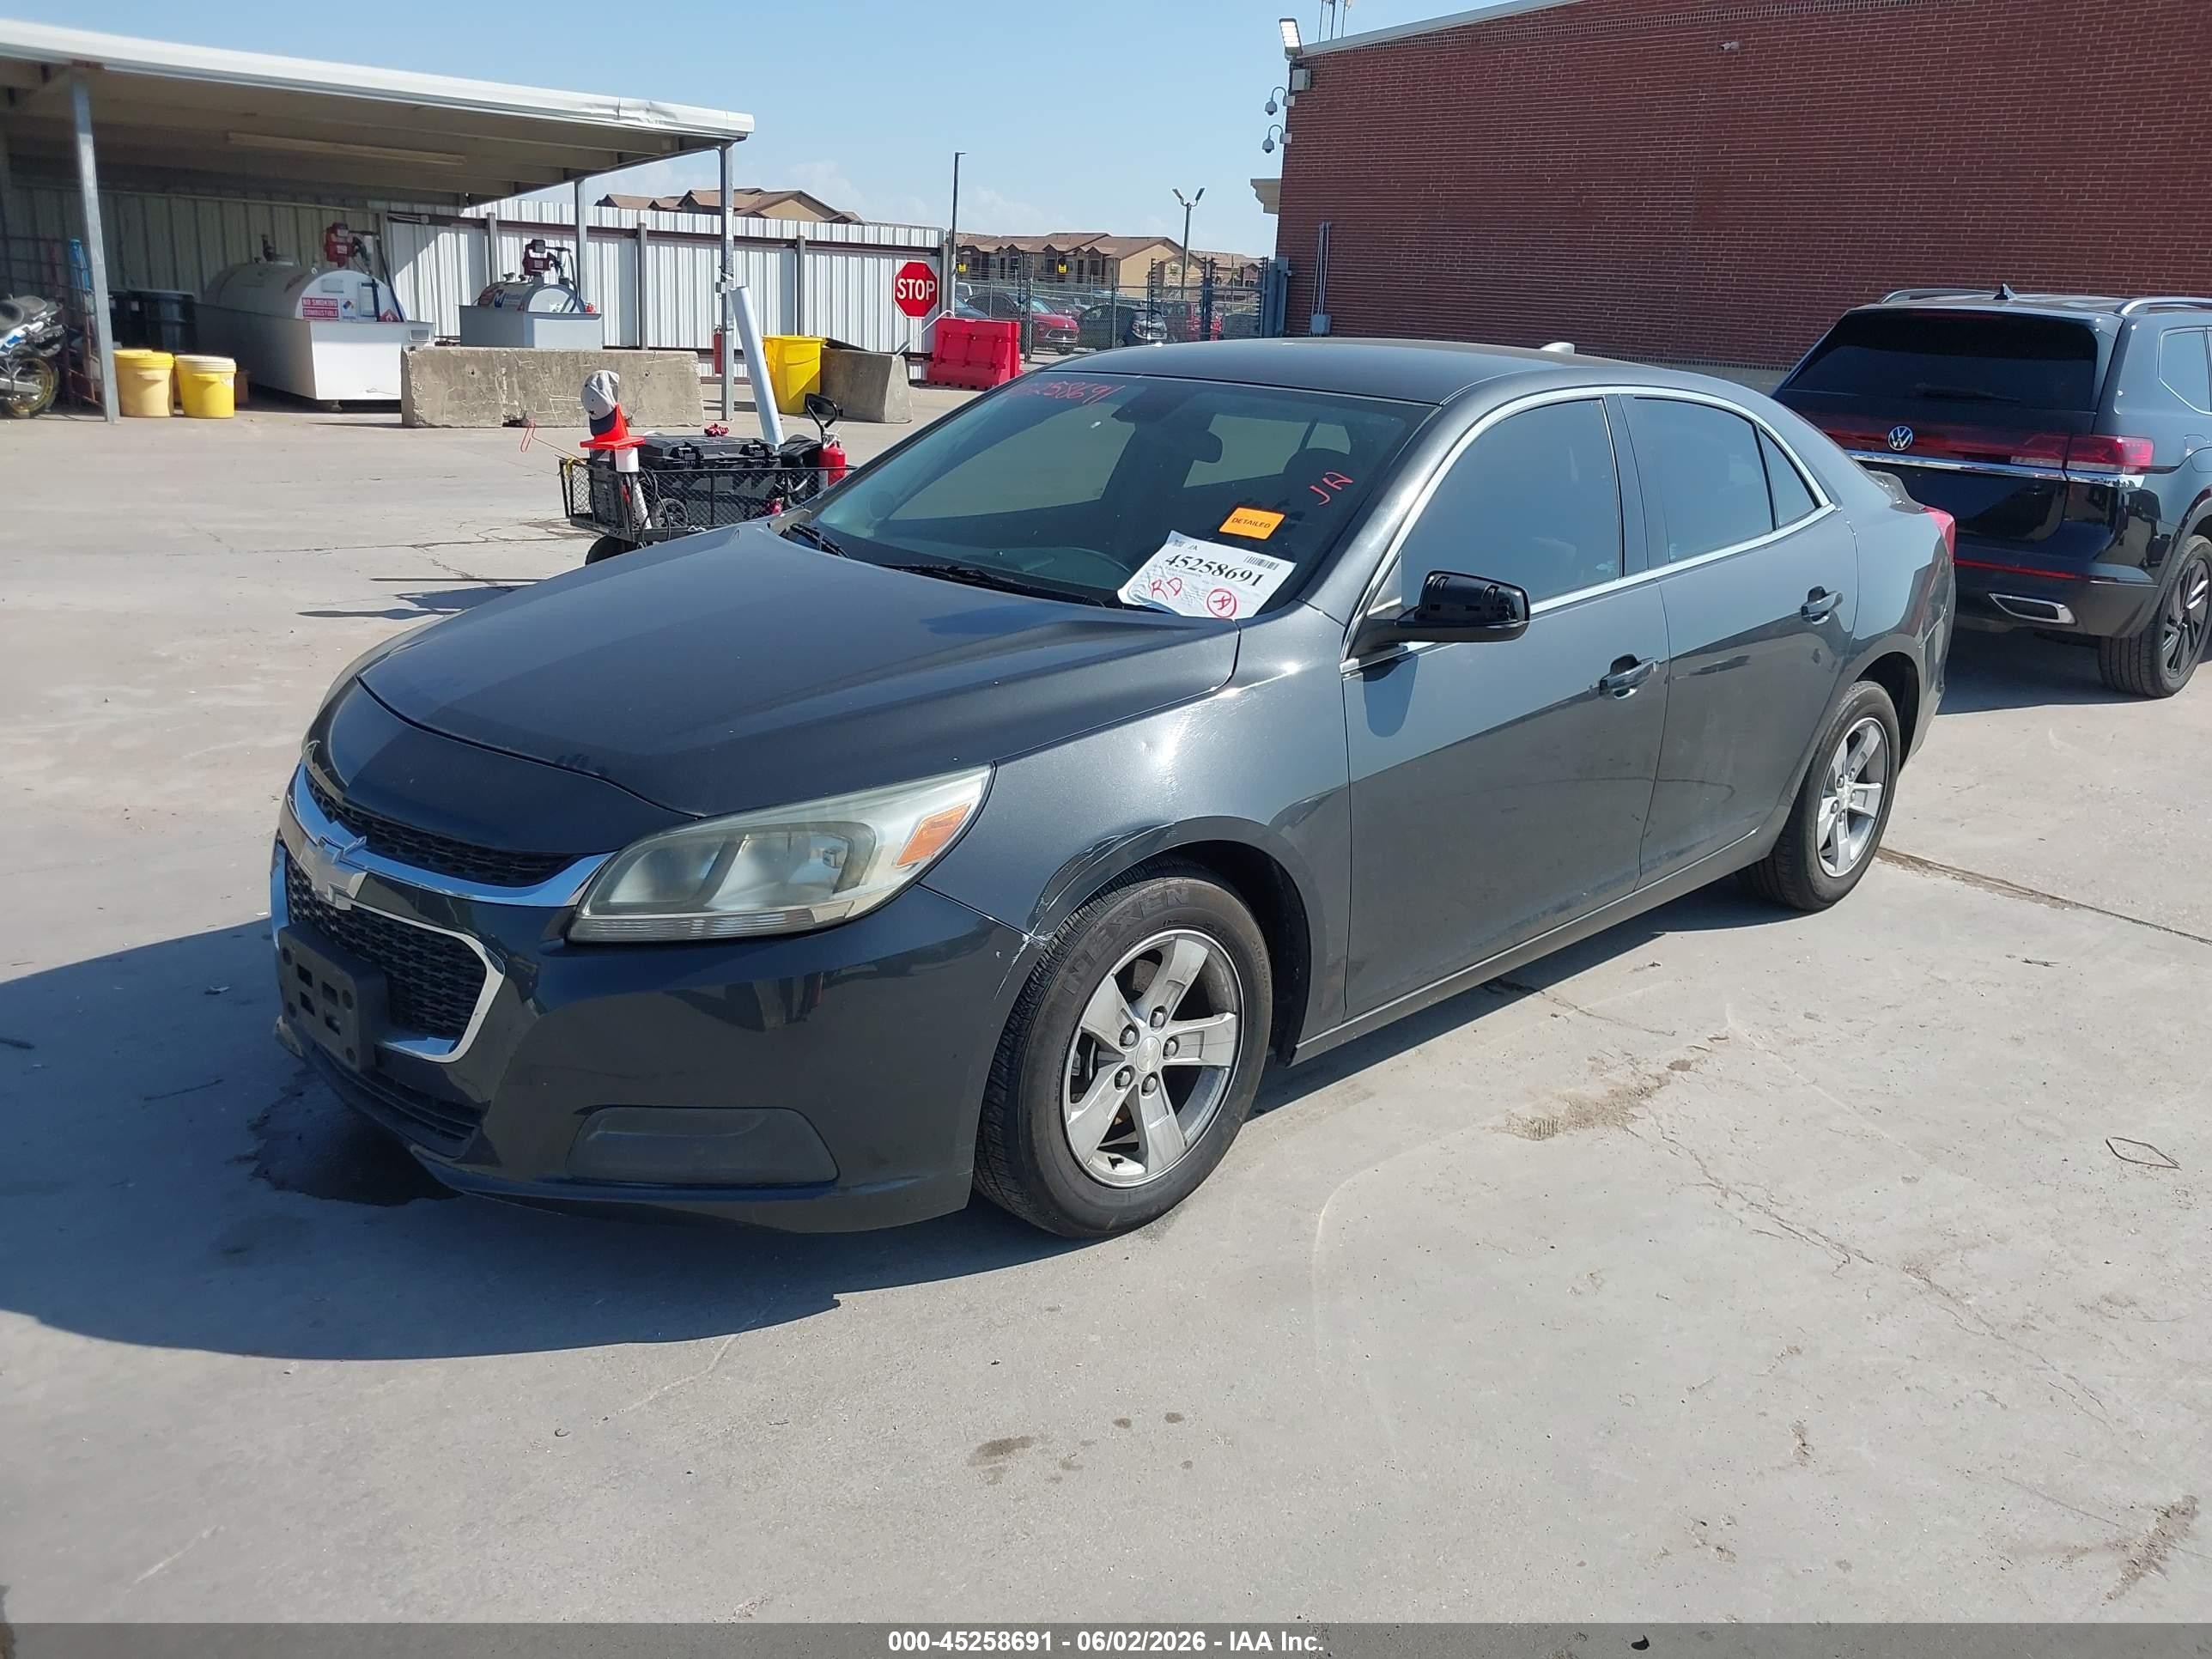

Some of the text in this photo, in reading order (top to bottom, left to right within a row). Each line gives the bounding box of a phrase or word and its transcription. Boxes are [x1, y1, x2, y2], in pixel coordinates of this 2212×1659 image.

[896, 278, 936, 301] STOP
[302, 298, 337, 307] NO SMOKING
[303, 308, 337, 317] COMBUSTIBLE
[1231, 517, 1271, 529] DETAILED
[1165, 554, 1265, 586] 45258691
